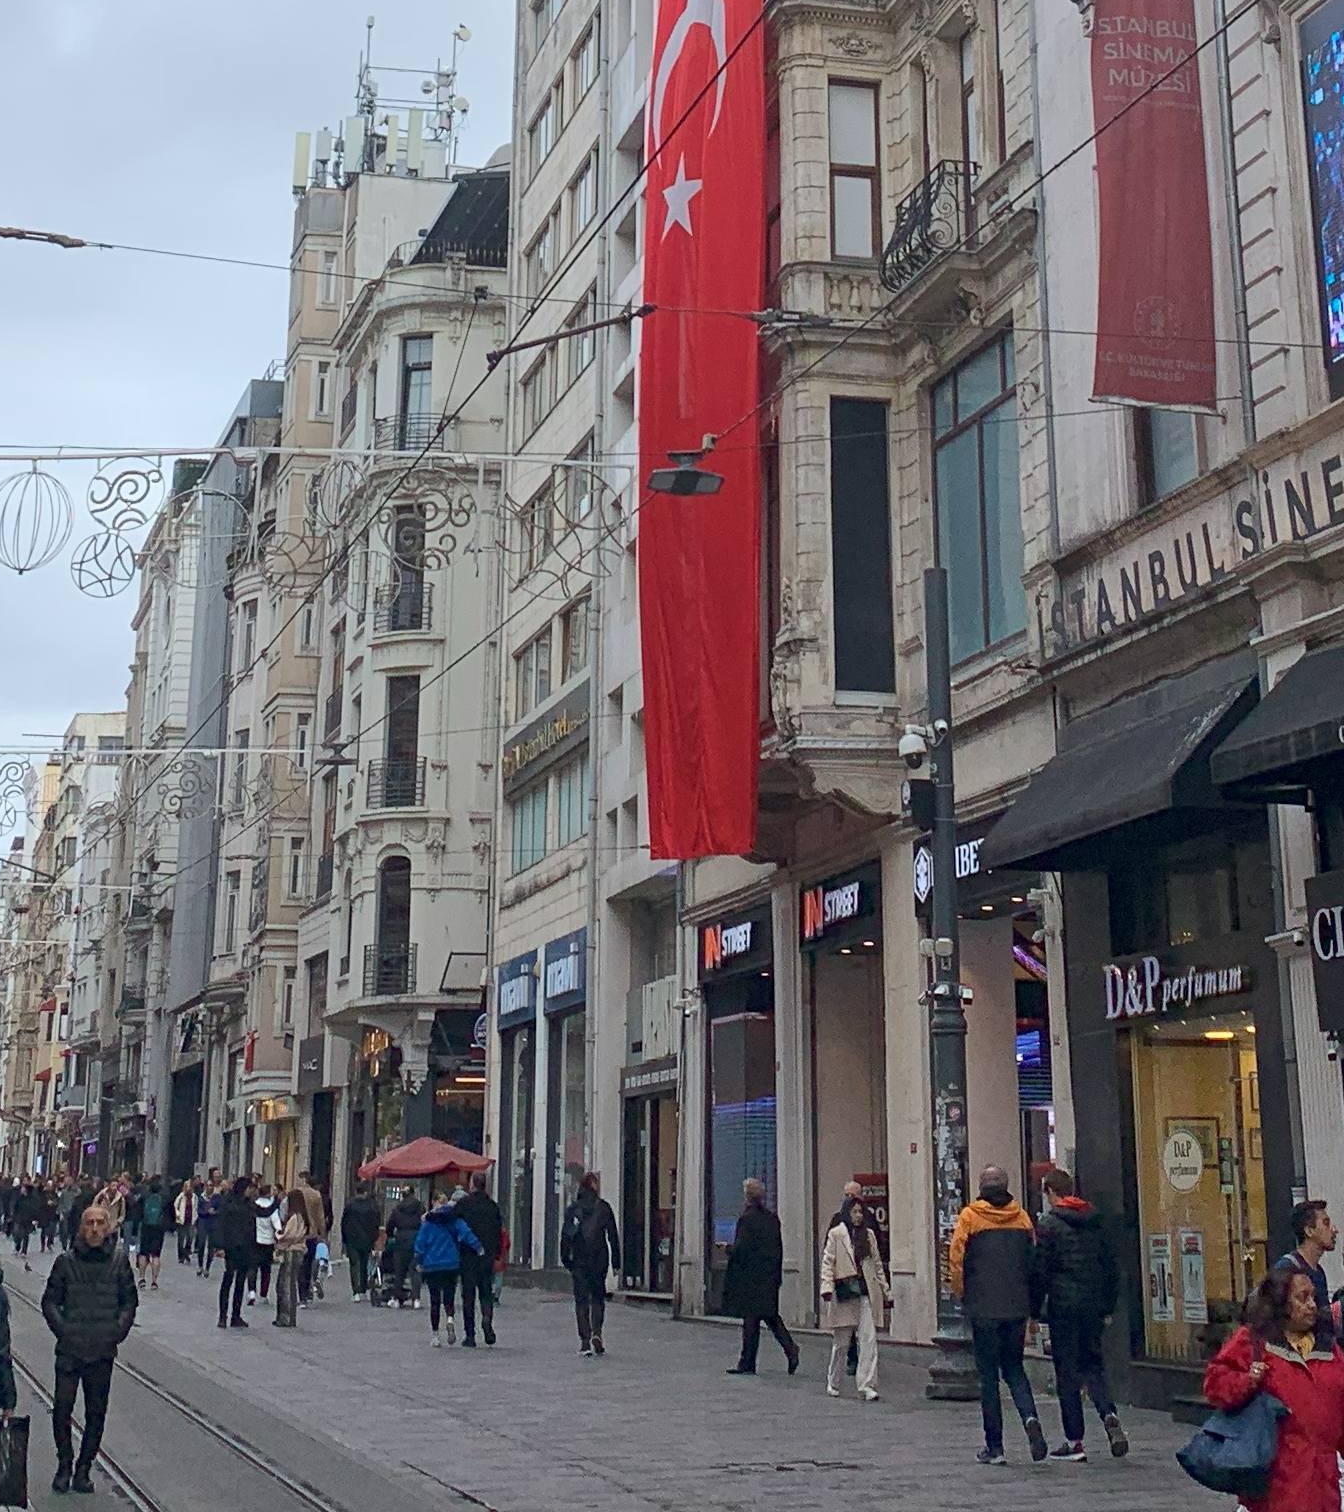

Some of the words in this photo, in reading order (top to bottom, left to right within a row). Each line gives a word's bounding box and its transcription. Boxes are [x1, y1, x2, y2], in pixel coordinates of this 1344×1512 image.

[1098, 16, 1196, 41] STANBUL
[1103, 38, 1192, 66] SİNEMA
[824, 881, 859, 922] STREET
[721, 921, 751, 957] STREET
[546, 942, 579, 999] mavi
[1103, 955, 1160, 1020] D&P
[1162, 963, 1242, 1011] perfumum
[1174, 1140, 1192, 1157] D&P
